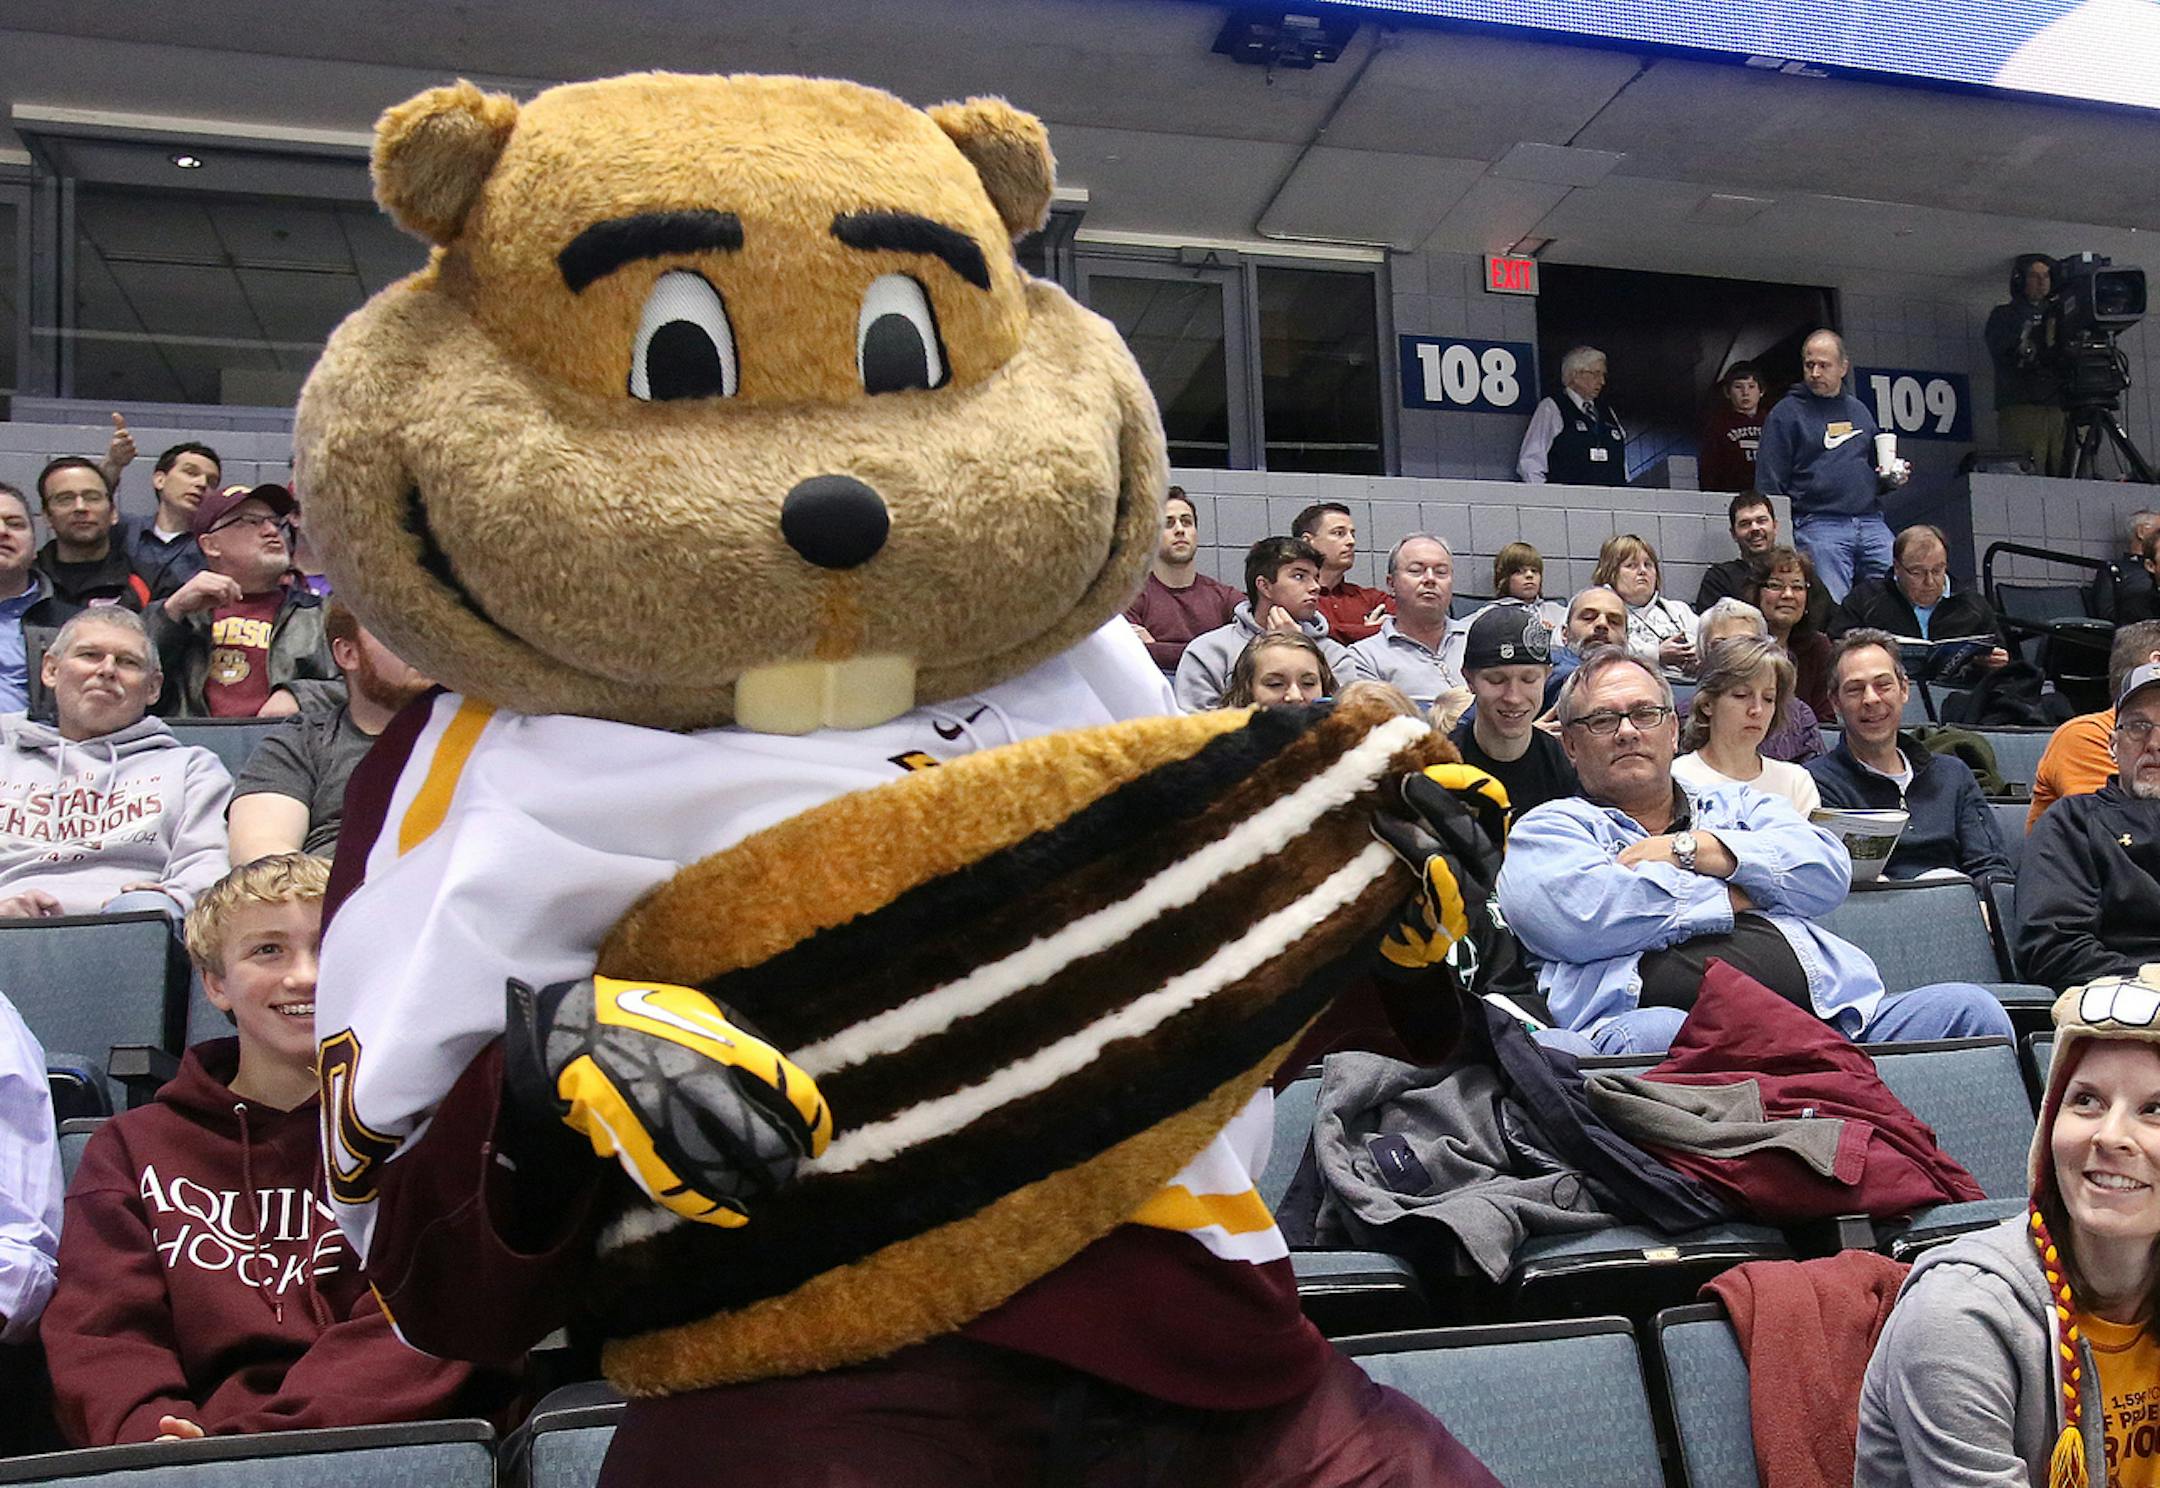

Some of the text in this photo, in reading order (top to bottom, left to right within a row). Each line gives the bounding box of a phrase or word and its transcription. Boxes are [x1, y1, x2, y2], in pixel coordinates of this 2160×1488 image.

[1491, 257, 1533, 290] EXIT
[1416, 342, 1520, 407] 108
[1870, 374, 1957, 433] 109
[27, 788, 126, 817] STATE
